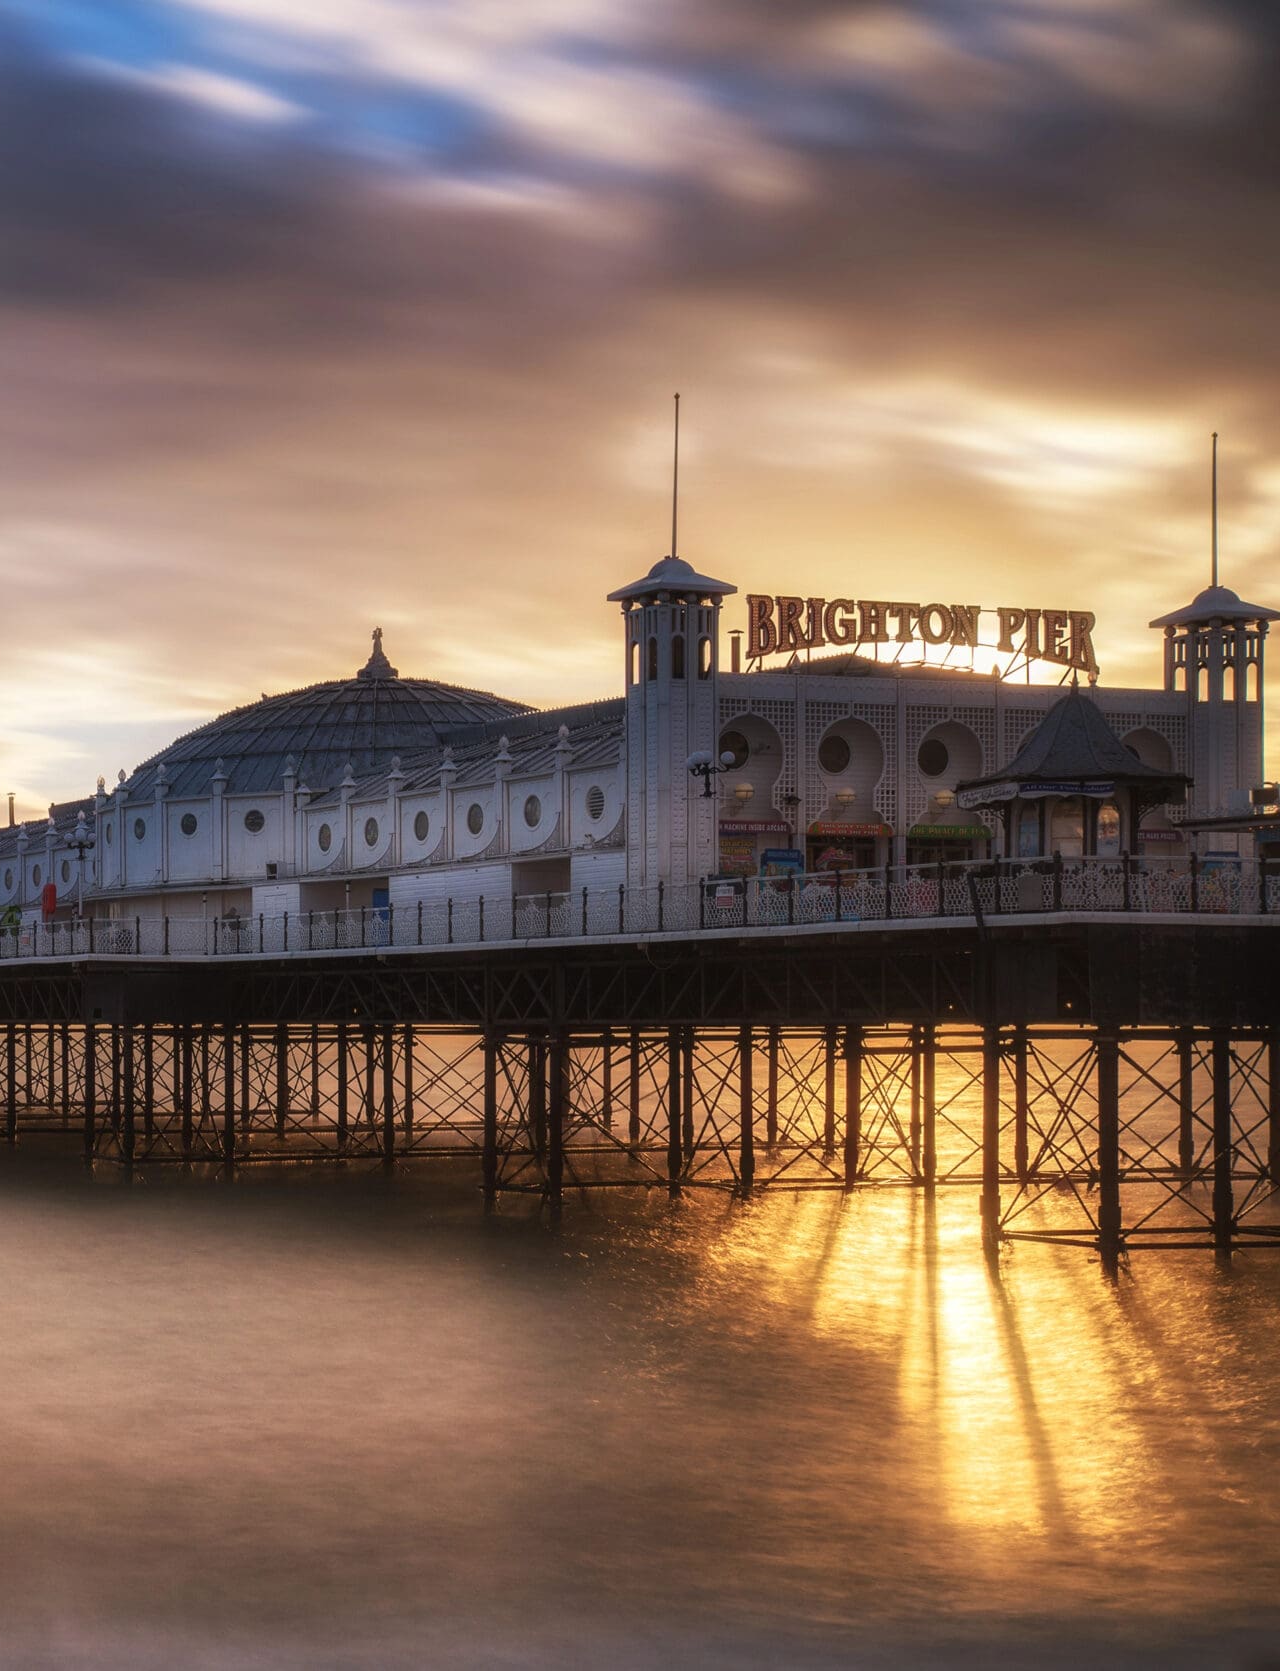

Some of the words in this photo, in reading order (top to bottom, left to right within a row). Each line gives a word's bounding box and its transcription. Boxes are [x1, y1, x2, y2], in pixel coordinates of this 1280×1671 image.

[745, 594, 981, 659] BRIGHTON
[997, 606, 1099, 675] PIER
[724, 823, 747, 832] MACHINE
[748, 823, 766, 832] INSIDE
[767, 824, 787, 833] ARCADE
[928, 827, 955, 835] PALACE
[959, 827, 968, 835] OF
